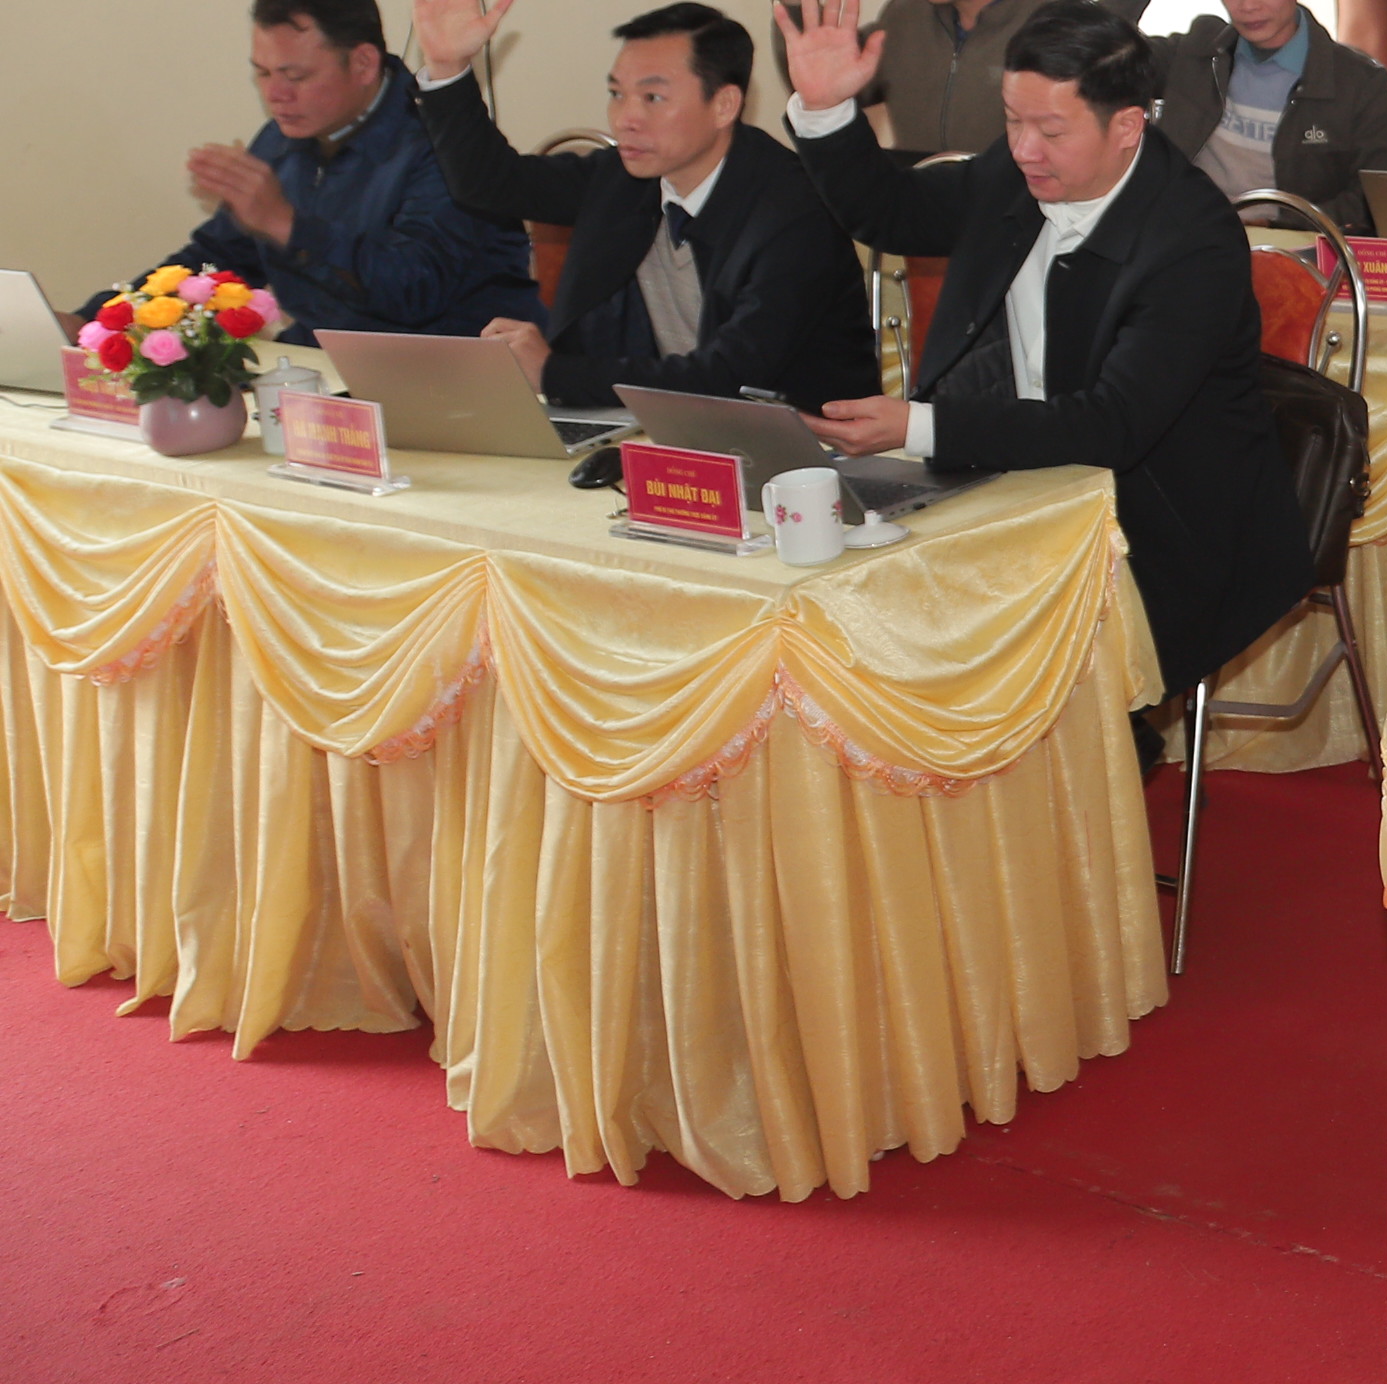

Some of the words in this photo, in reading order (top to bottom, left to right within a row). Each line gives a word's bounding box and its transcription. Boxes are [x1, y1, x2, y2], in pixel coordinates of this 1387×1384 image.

[1363, 259, 1387, 274] XUÂN
[646, 478, 666, 497] BÙI
[668, 483, 698, 504] NHẬT
[700, 489, 721, 508] ĐẠI
